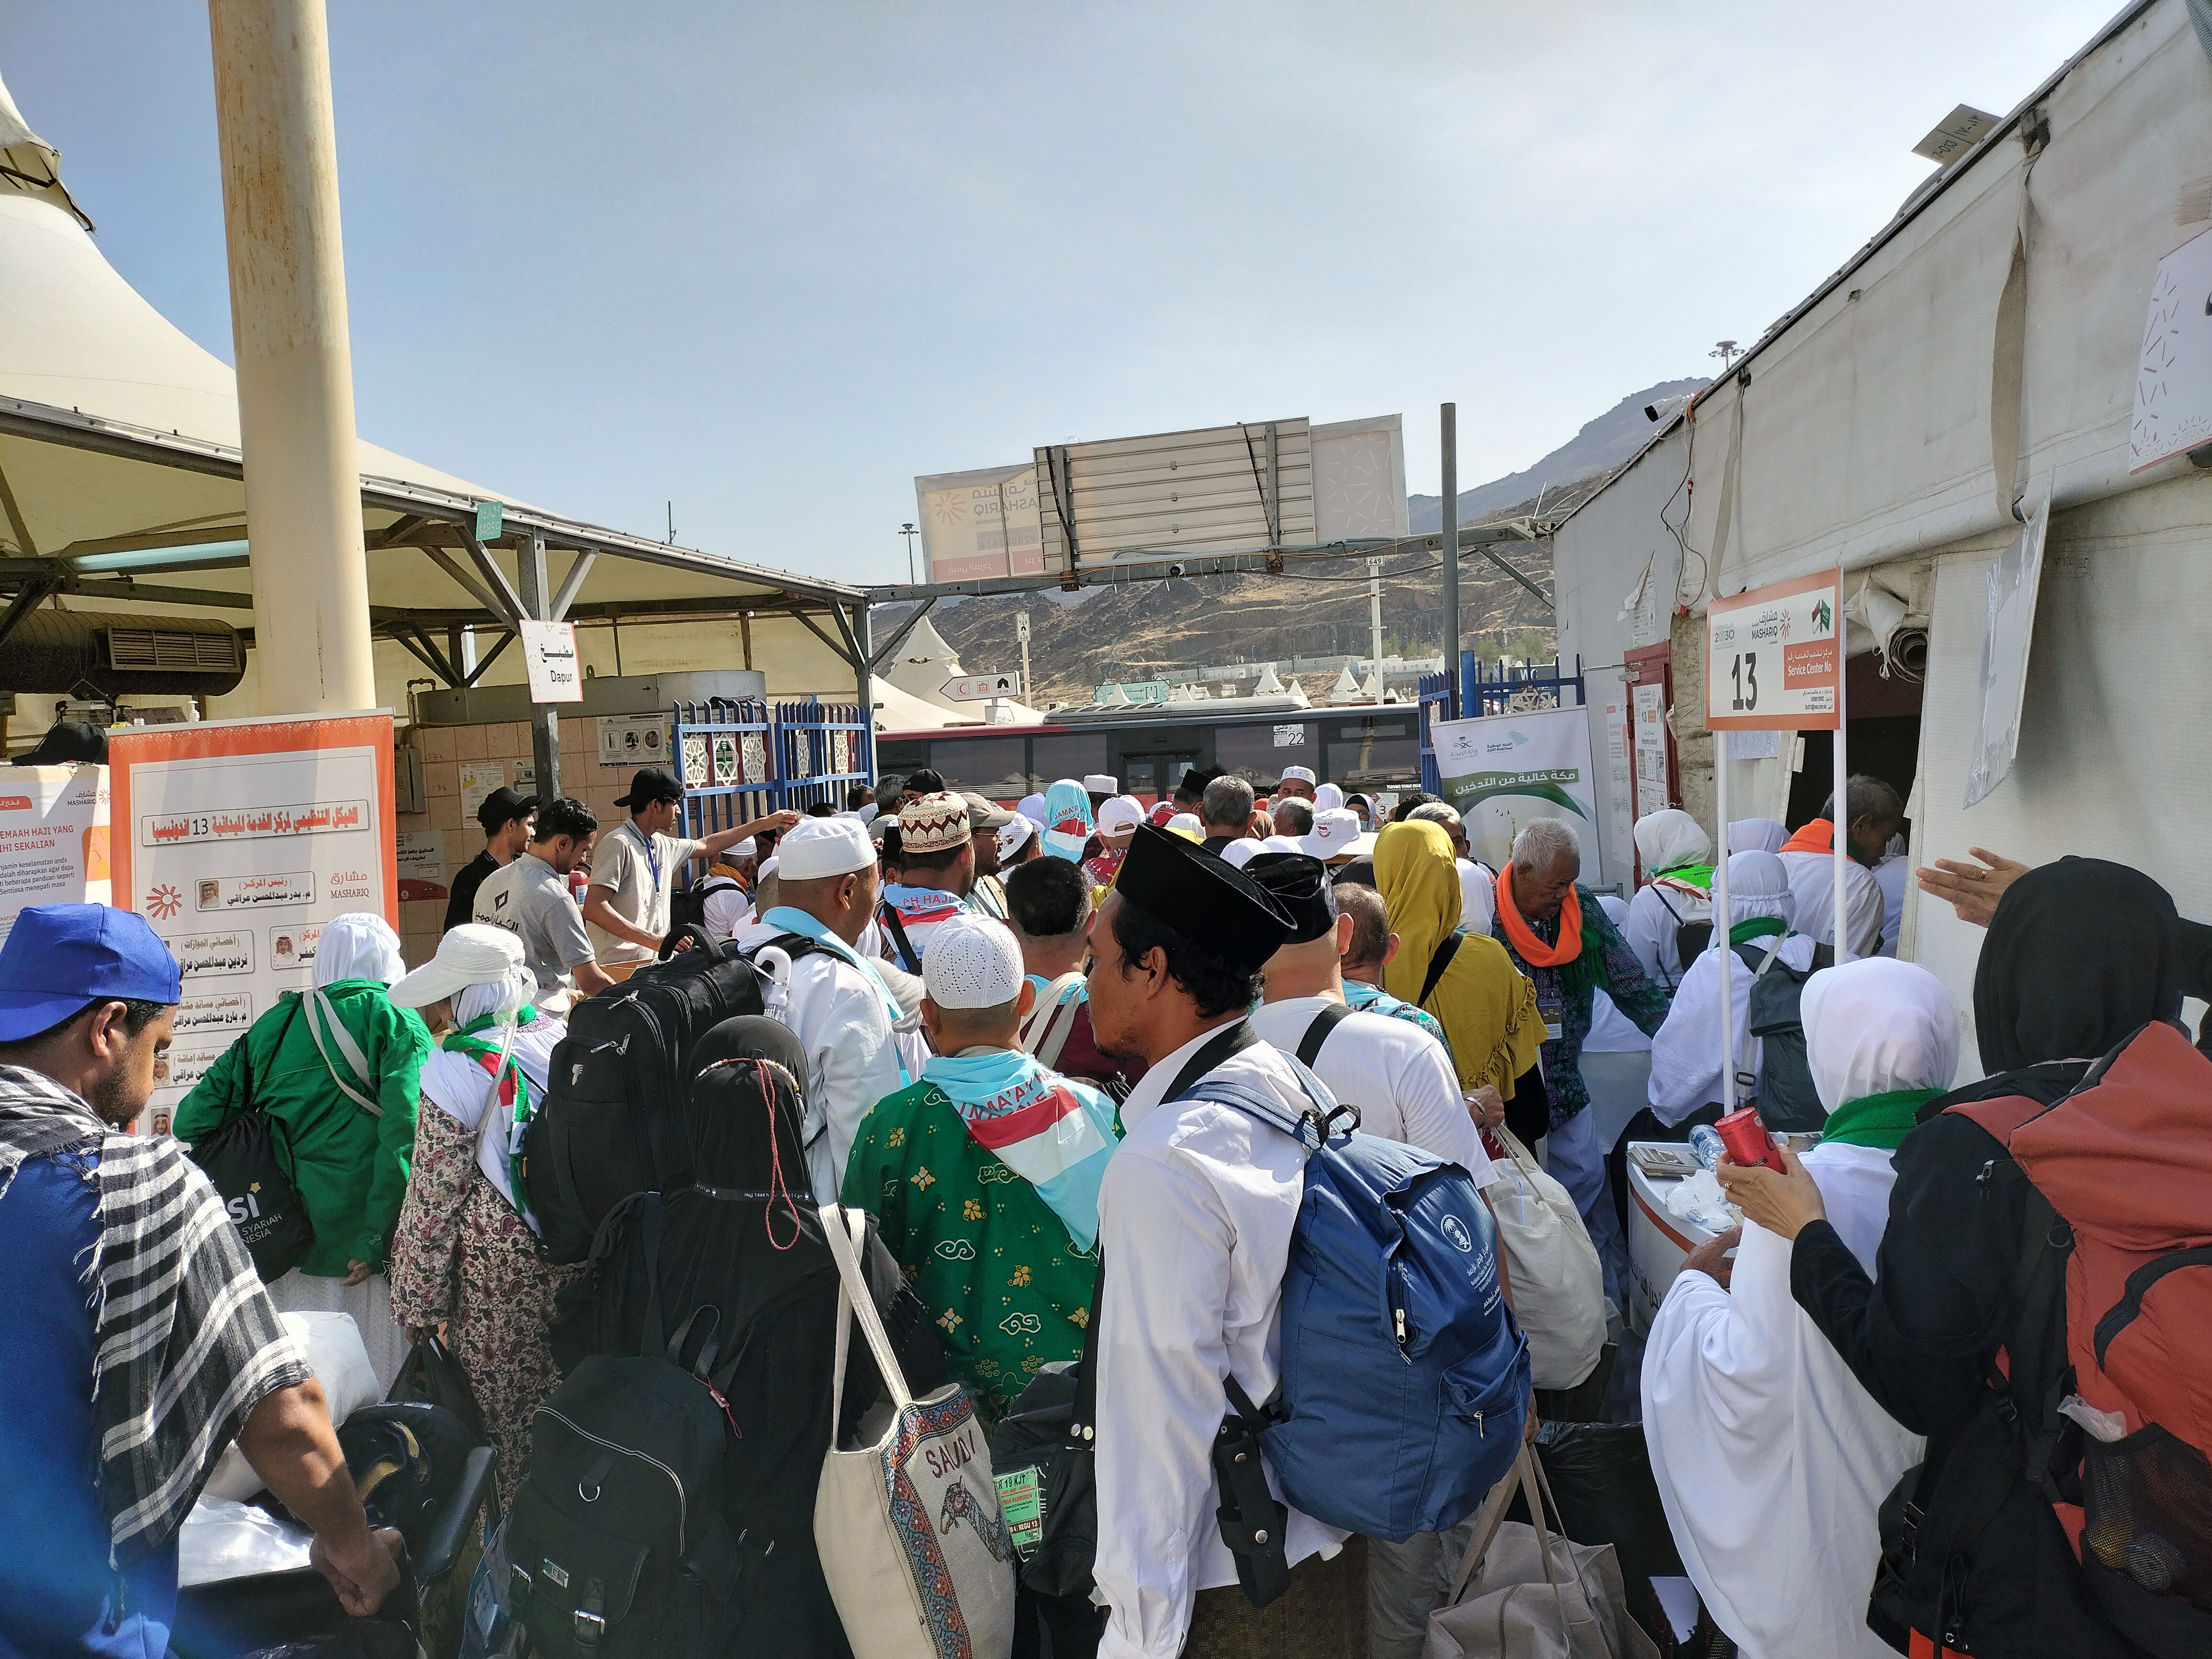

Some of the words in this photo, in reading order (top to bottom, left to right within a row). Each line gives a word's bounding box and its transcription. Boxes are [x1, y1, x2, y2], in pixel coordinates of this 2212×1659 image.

[1751, 626, 1778, 640] MASHARIQ
[1788, 665, 1806, 677] Service
[1806, 663, 1824, 675] Center
[1824, 661, 1832, 673] No
[550, 670, 573, 686] Dapur
[1731, 652, 1758, 711] 13
[1288, 732, 1304, 745] 22
[1498, 776, 1516, 786] من
[1518, 772, 1549, 784] خالية
[1550, 770, 1576, 781] مكة
[1455, 777, 1496, 795] التدخين
[75, 790, 96, 798] مشارق
[1379, 806, 1386, 815] 3
[32, 827, 51, 836] HAJI
[52, 825, 74, 834] YANG
[192, 818, 209, 835] 13
[14, 839, 55, 851] SEKALIAN
[19, 859, 54, 869] keselamatan
[17, 867, 47, 877] diharapkan
[331, 871, 367, 885] مشارق
[5, 877, 32, 888] beberapa
[32, 875, 55, 884] panduan
[56, 872, 75, 880] seperti
[0, 886, 24, 895] Sentiasa
[25, 883, 51, 893] menepati
[330, 888, 370, 899] MASHARIQ
[923, 894, 951, 904] HAJI
[242, 1213, 283, 1236] SYARIAH
[925, 1429, 975, 1479] SAUDI
[1005, 1479, 1013, 1488] 19
[1014, 1474, 1026, 1484] KJT
[1018, 1522, 1030, 1531] REGU
